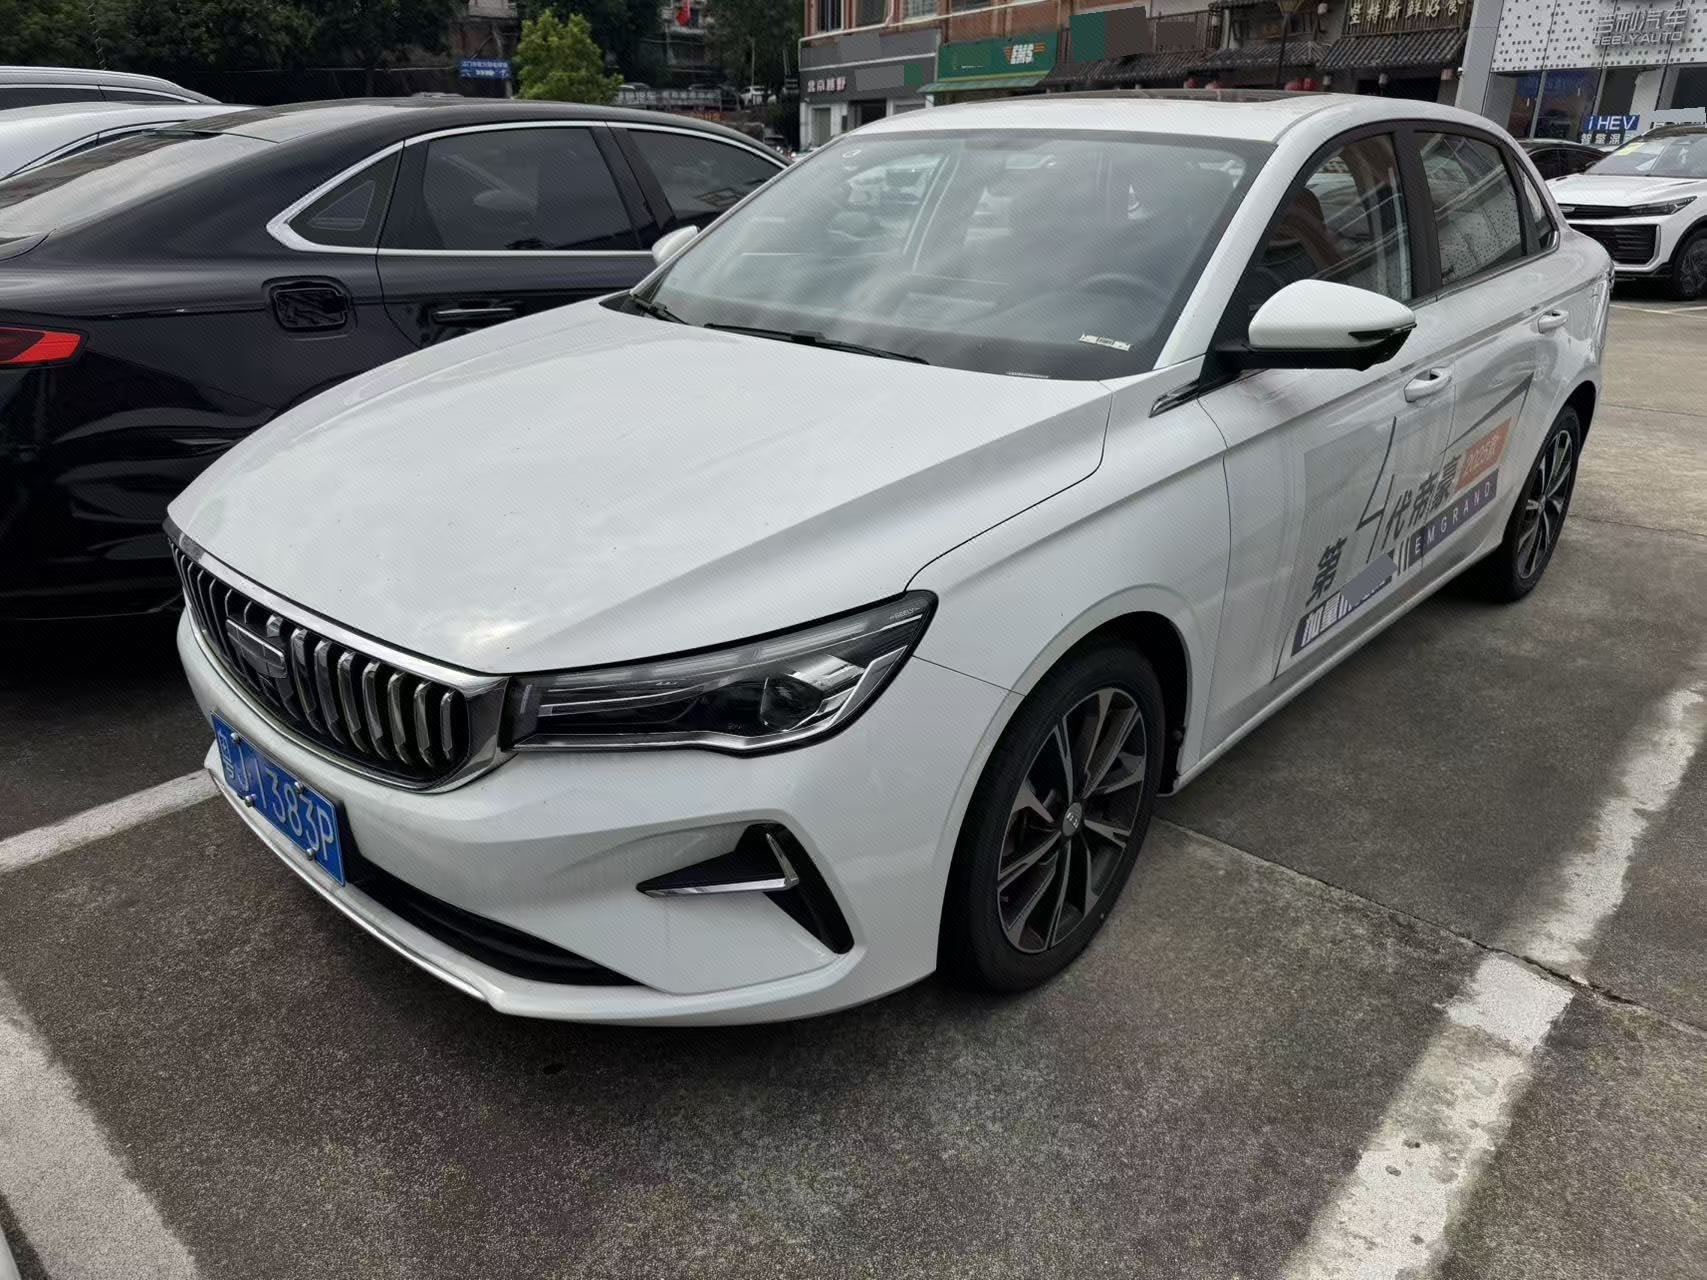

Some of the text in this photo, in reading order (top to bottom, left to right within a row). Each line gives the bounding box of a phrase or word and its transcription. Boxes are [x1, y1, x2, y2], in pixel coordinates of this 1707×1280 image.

[1594, 8, 1687, 33] 吉利汽车
[1414, 480, 1491, 554] EMGRAND
